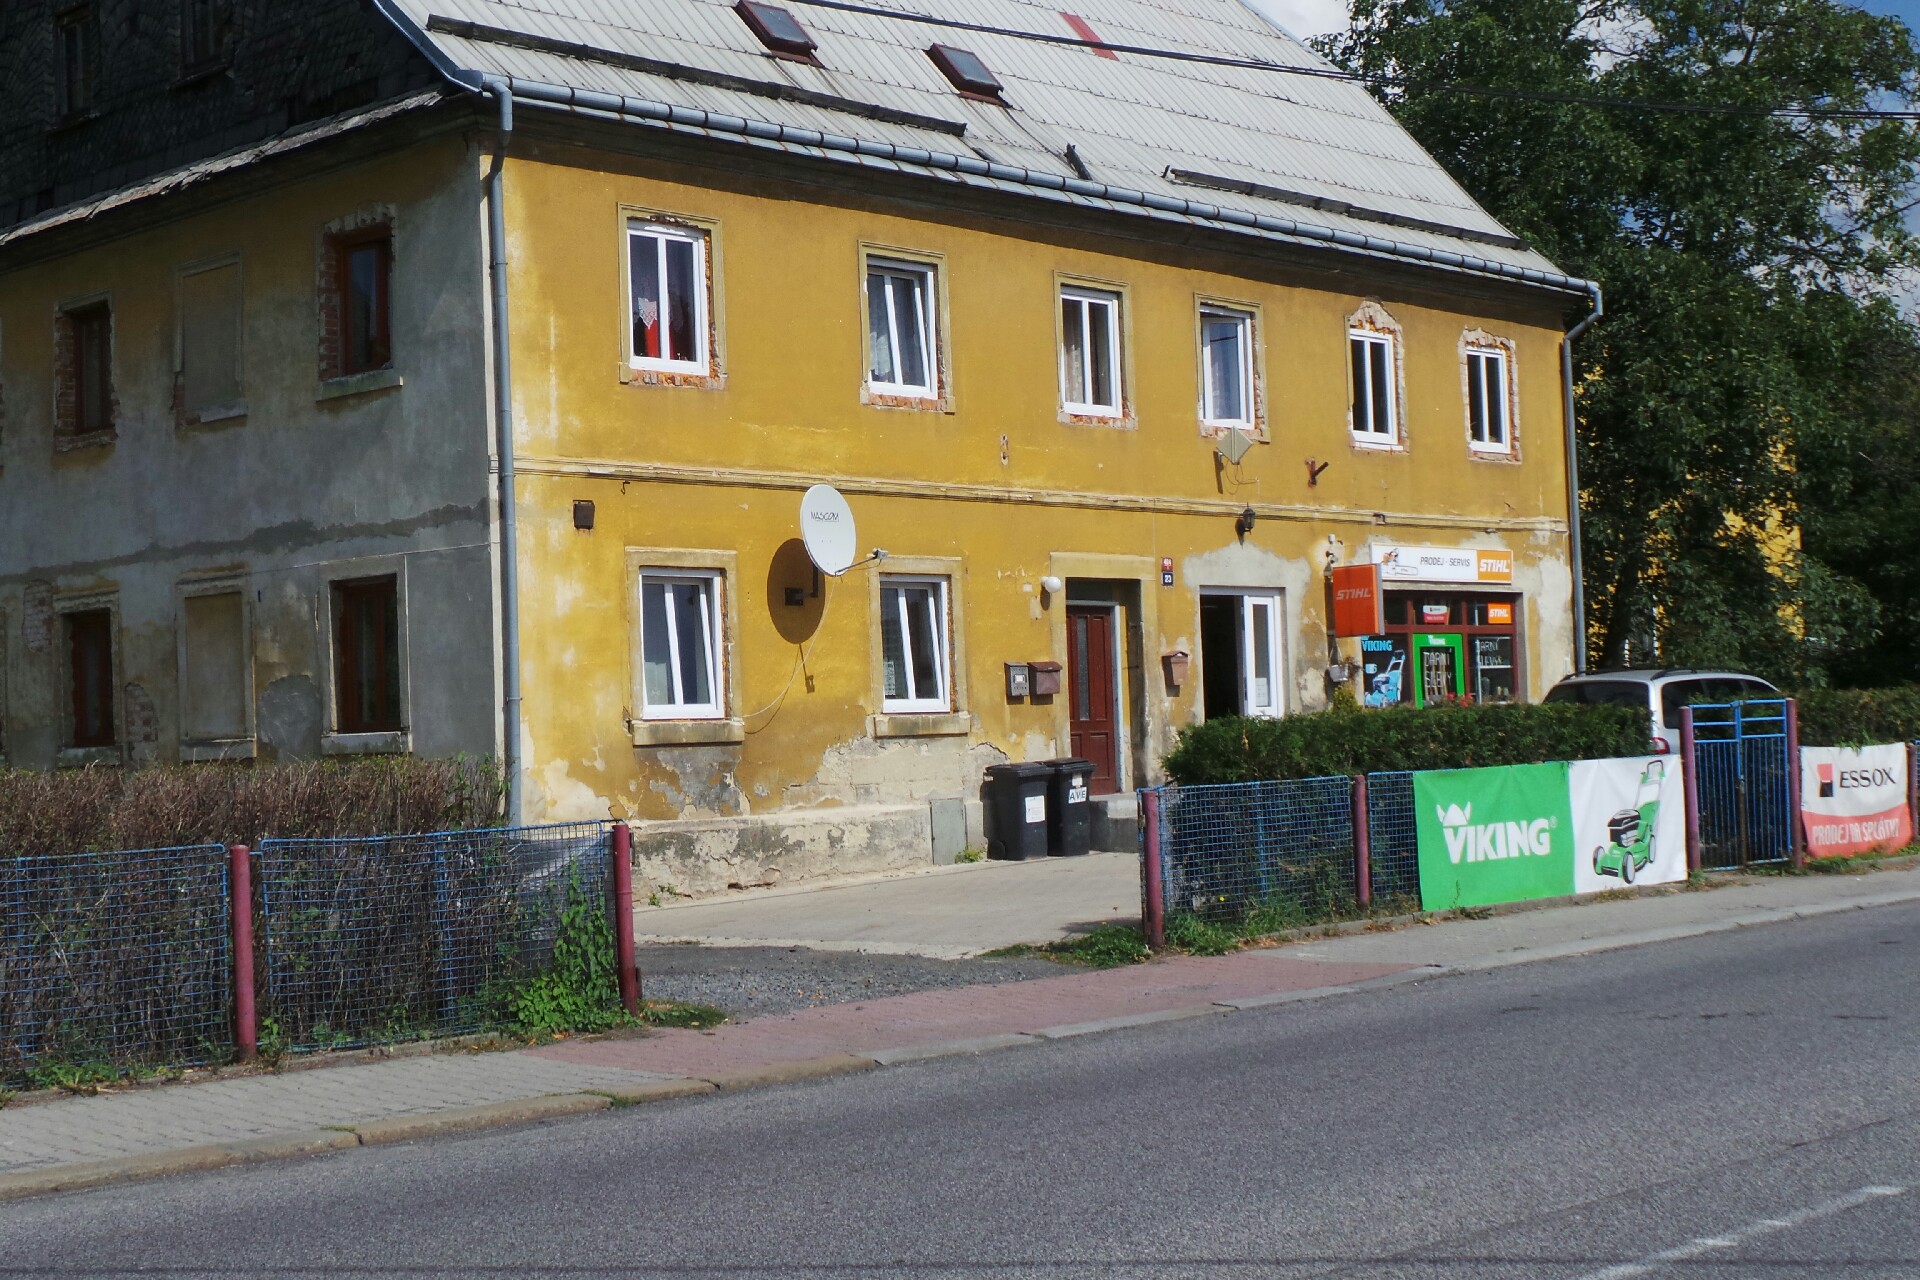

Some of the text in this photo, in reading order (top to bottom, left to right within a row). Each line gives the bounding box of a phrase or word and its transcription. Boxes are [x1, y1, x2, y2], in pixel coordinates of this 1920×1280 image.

[811, 512, 839, 522] MASCOM
[1420, 556, 1444, 566] PRODEJ
[1450, 558, 1470, 567] SERVIS
[1480, 560, 1510, 572] STIHL
[1336, 588, 1371, 600] STIHL
[1489, 608, 1508, 617] STIHL
[1362, 640, 1392, 651] VIKING
[1840, 767, 1896, 788] ESSOX
[1070, 791, 1086, 800] AVE
[1812, 824, 1850, 846] PRODEJ
[1443, 818, 1551, 864] VIKING
